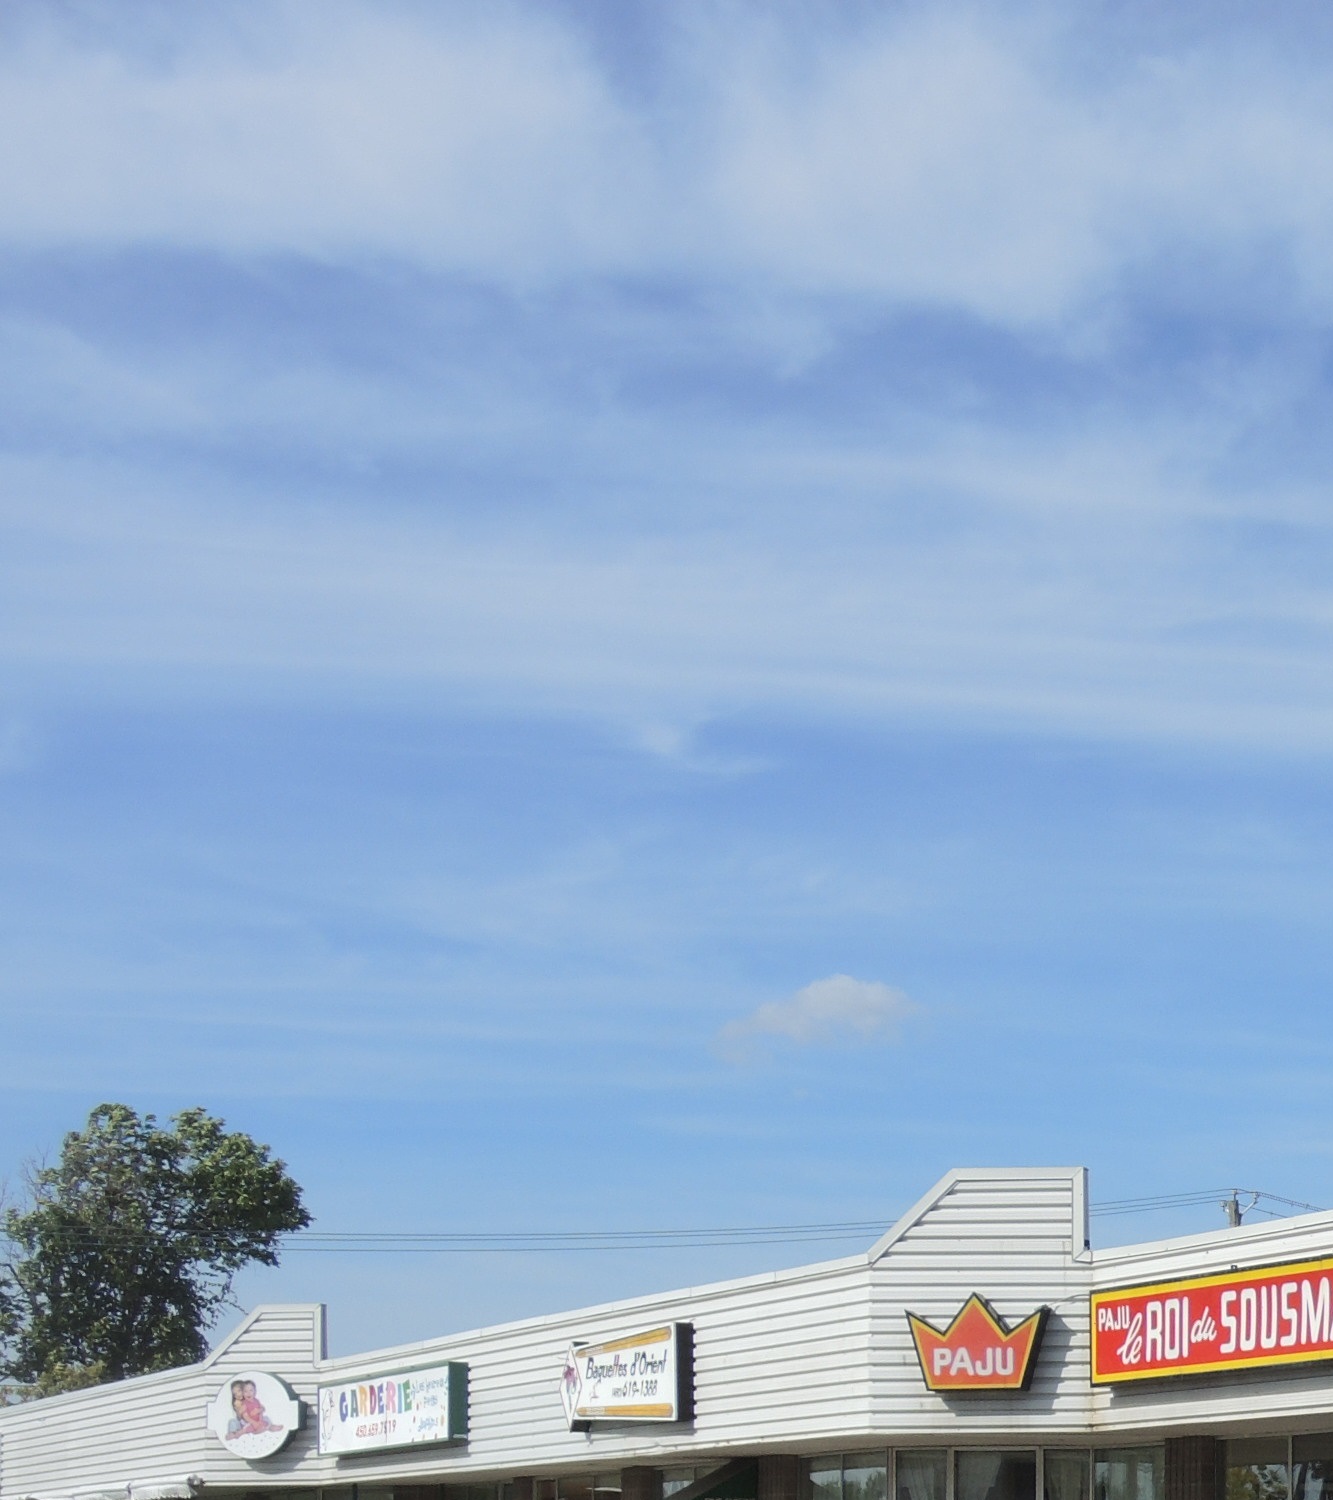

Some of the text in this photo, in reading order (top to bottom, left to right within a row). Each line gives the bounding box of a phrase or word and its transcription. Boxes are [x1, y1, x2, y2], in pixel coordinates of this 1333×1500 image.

[1098, 1304, 1131, 1332] PAJU
[1116, 1311, 1143, 1365] le
[1145, 1295, 1189, 1363] ROI
[1190, 1305, 1218, 1343] du
[585, 1349, 668, 1384] Baguettes d'Orient
[932, 1346, 1015, 1377] PAJU
[338, 1378, 413, 1423] GARDERIE
